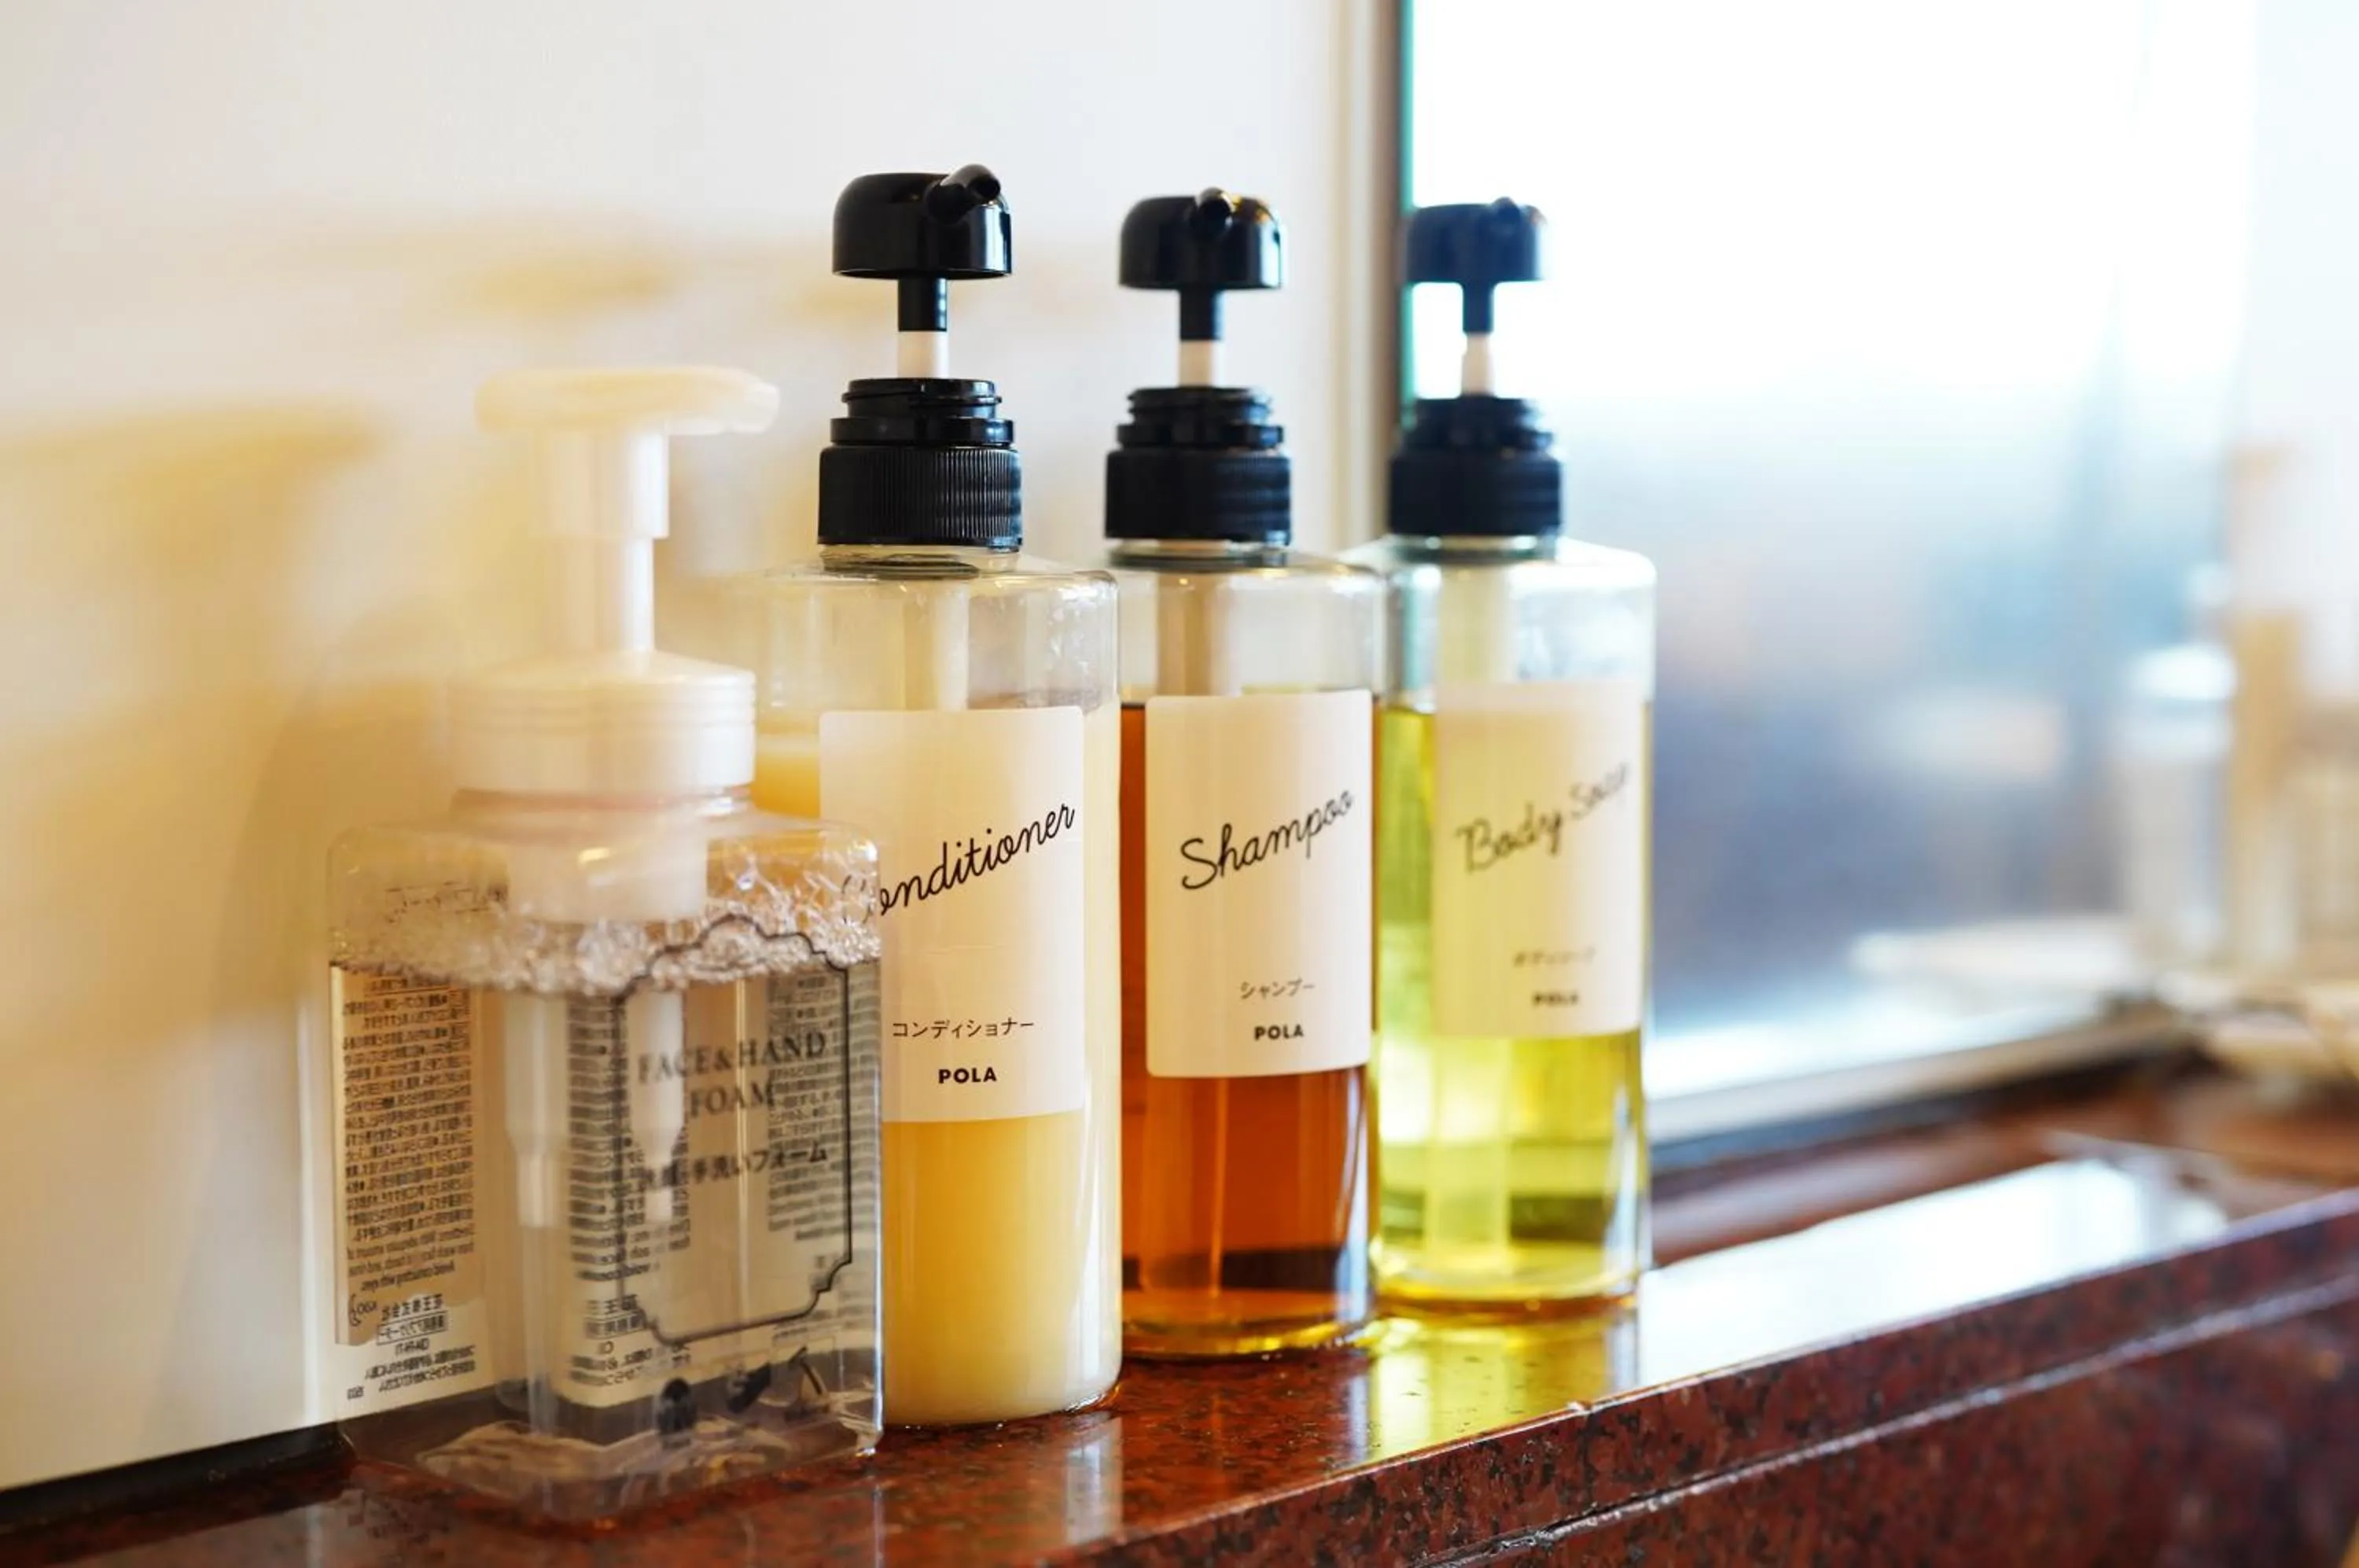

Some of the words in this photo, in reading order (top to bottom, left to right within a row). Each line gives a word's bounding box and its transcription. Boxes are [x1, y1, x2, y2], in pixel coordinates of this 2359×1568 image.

[1180, 790, 1353, 890] Shampoo
[1453, 799, 1562, 875] Body
[892, 1017, 1035, 1039] コンディショナー
[1253, 1023, 1305, 1041] POLA
[937, 1066, 998, 1084] POLA
[689, 1077, 775, 1118] FOAM
